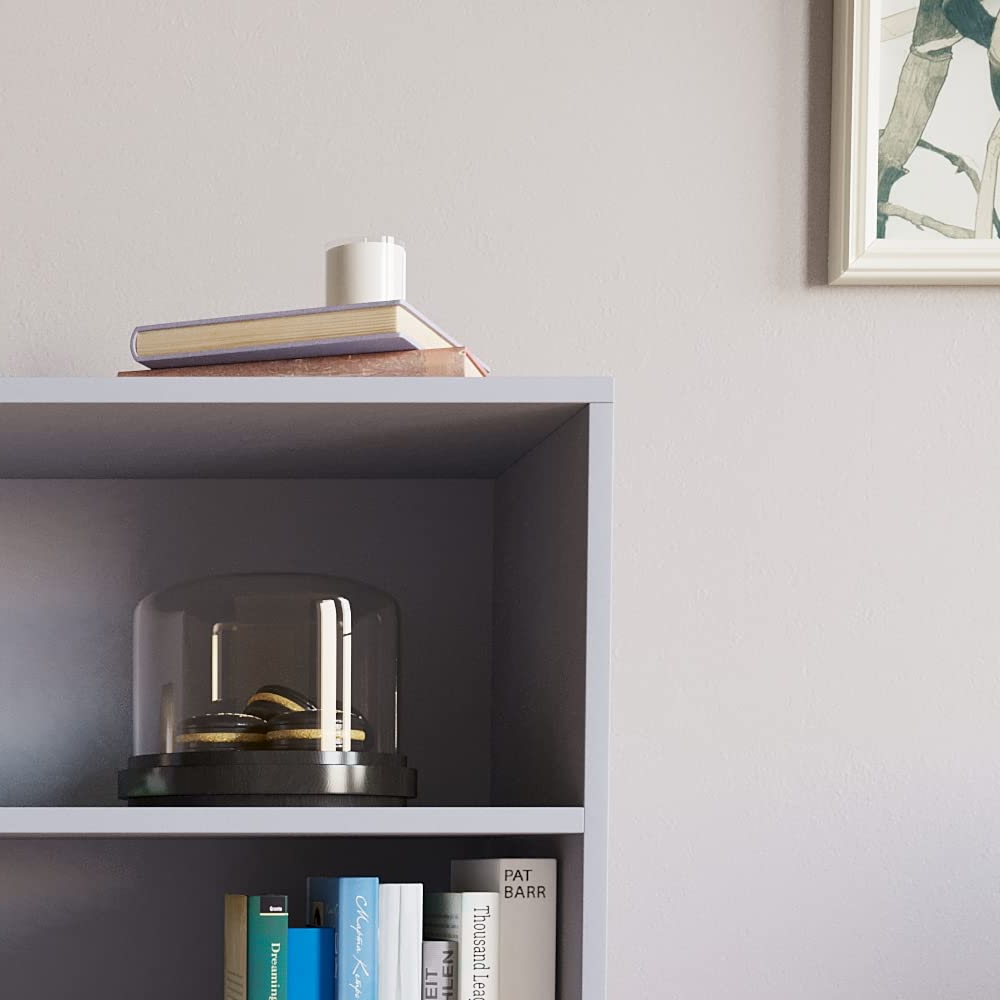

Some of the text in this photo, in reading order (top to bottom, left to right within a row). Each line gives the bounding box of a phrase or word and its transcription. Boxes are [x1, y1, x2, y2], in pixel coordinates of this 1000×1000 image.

[504, 869, 532, 882] PAT
[504, 885, 546, 899] BARR
[473, 905, 491, 970] Thousand
